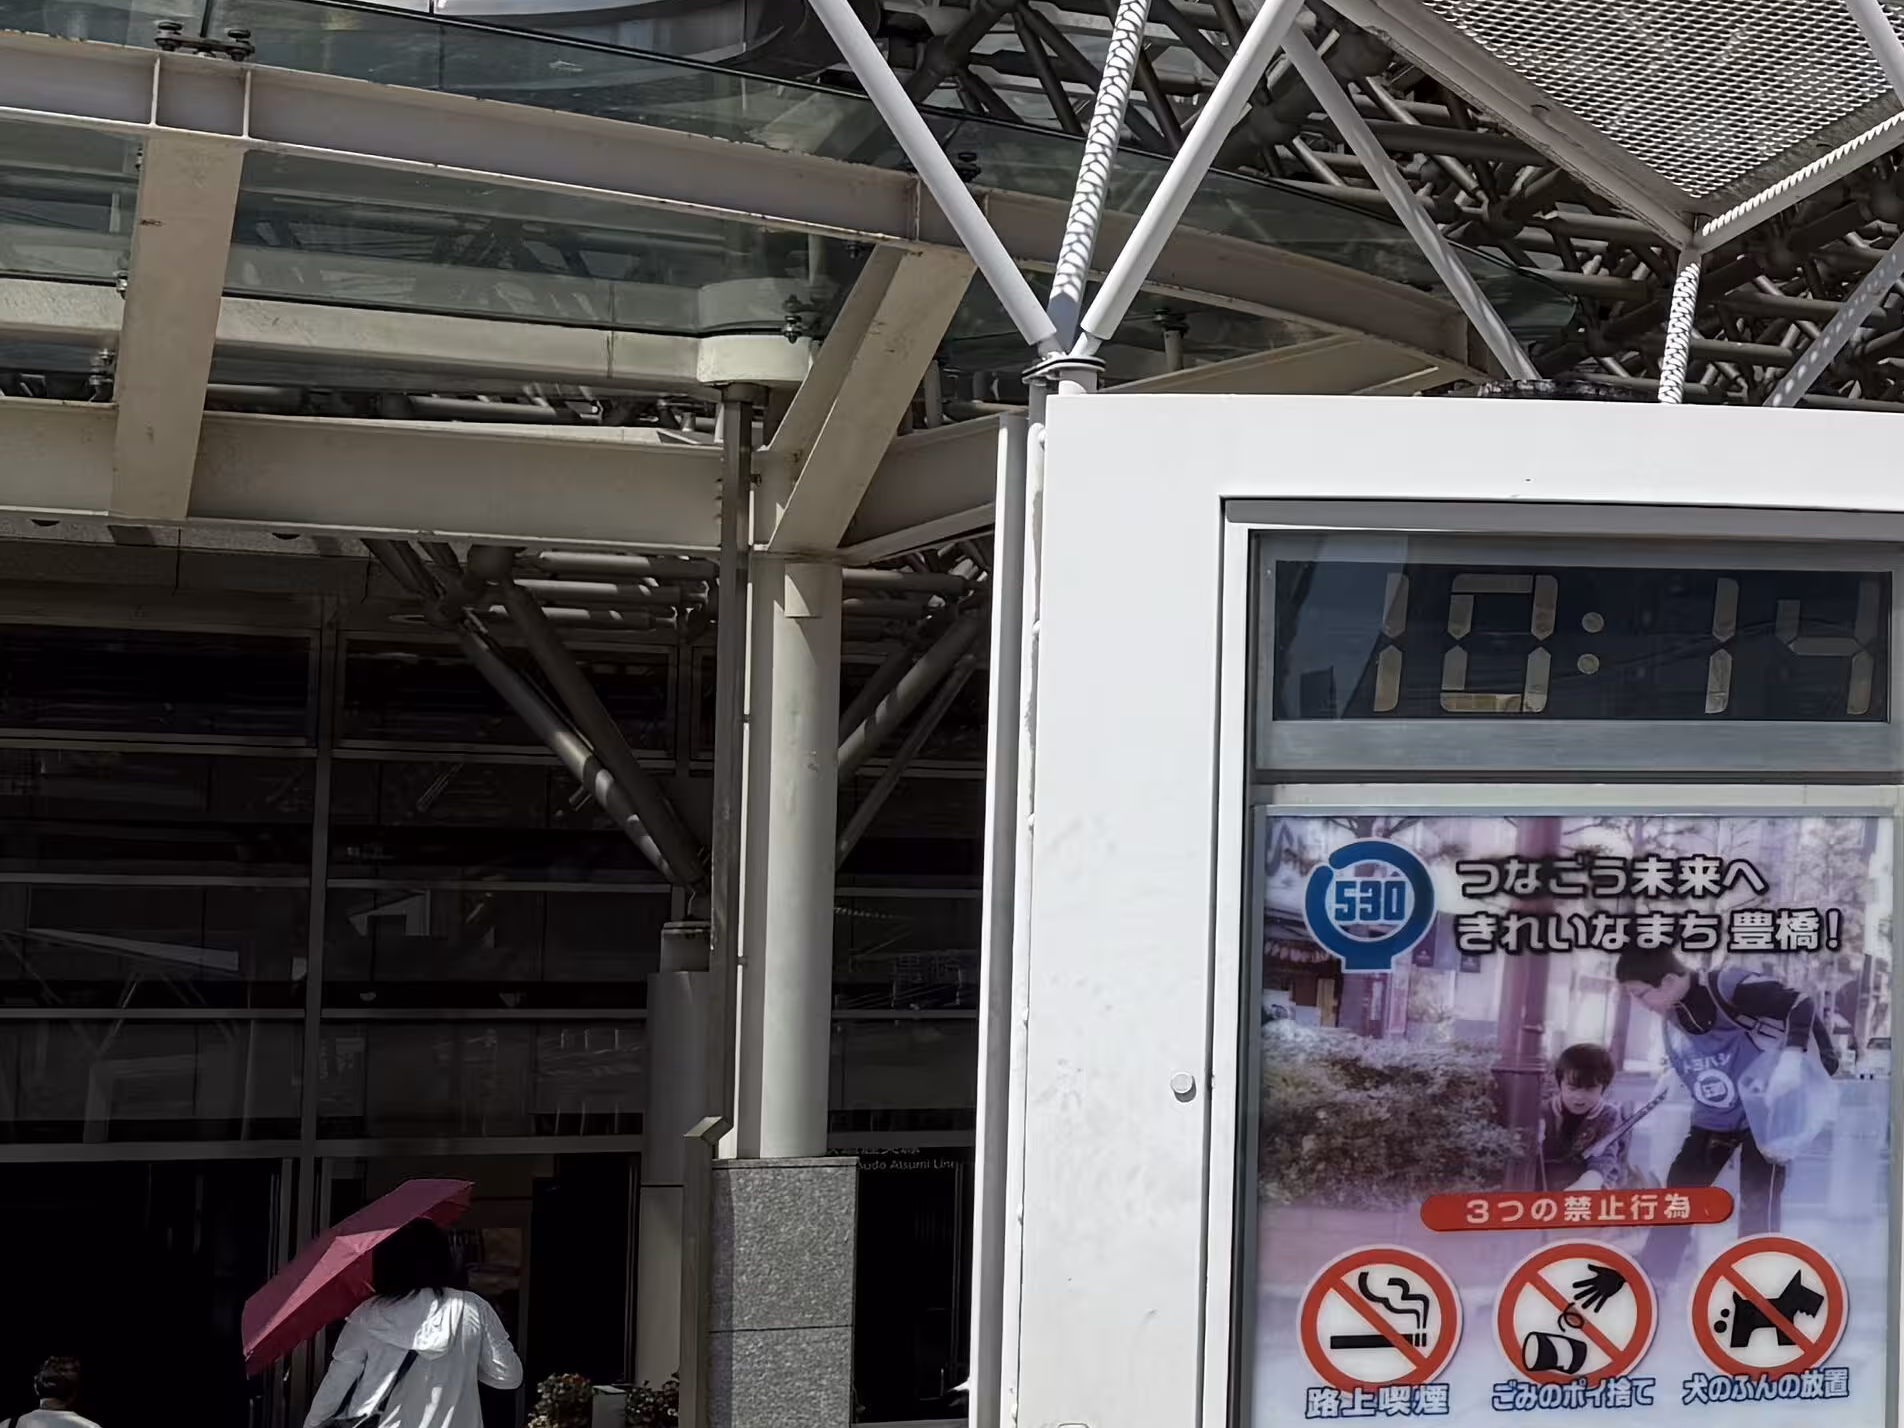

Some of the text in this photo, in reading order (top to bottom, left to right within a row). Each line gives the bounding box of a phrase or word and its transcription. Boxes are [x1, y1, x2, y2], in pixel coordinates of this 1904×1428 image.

[1373, 572, 1881, 715] 10:14
[1457, 854, 1769, 898] つなごう未来へ
[1334, 879, 1406, 925] 530
[1466, 1193, 1691, 1224] 3つの禁止行為
[1305, 1366, 1851, 1420] 路上喫煙 ごみのポイ捨て 犬のふんの放置
